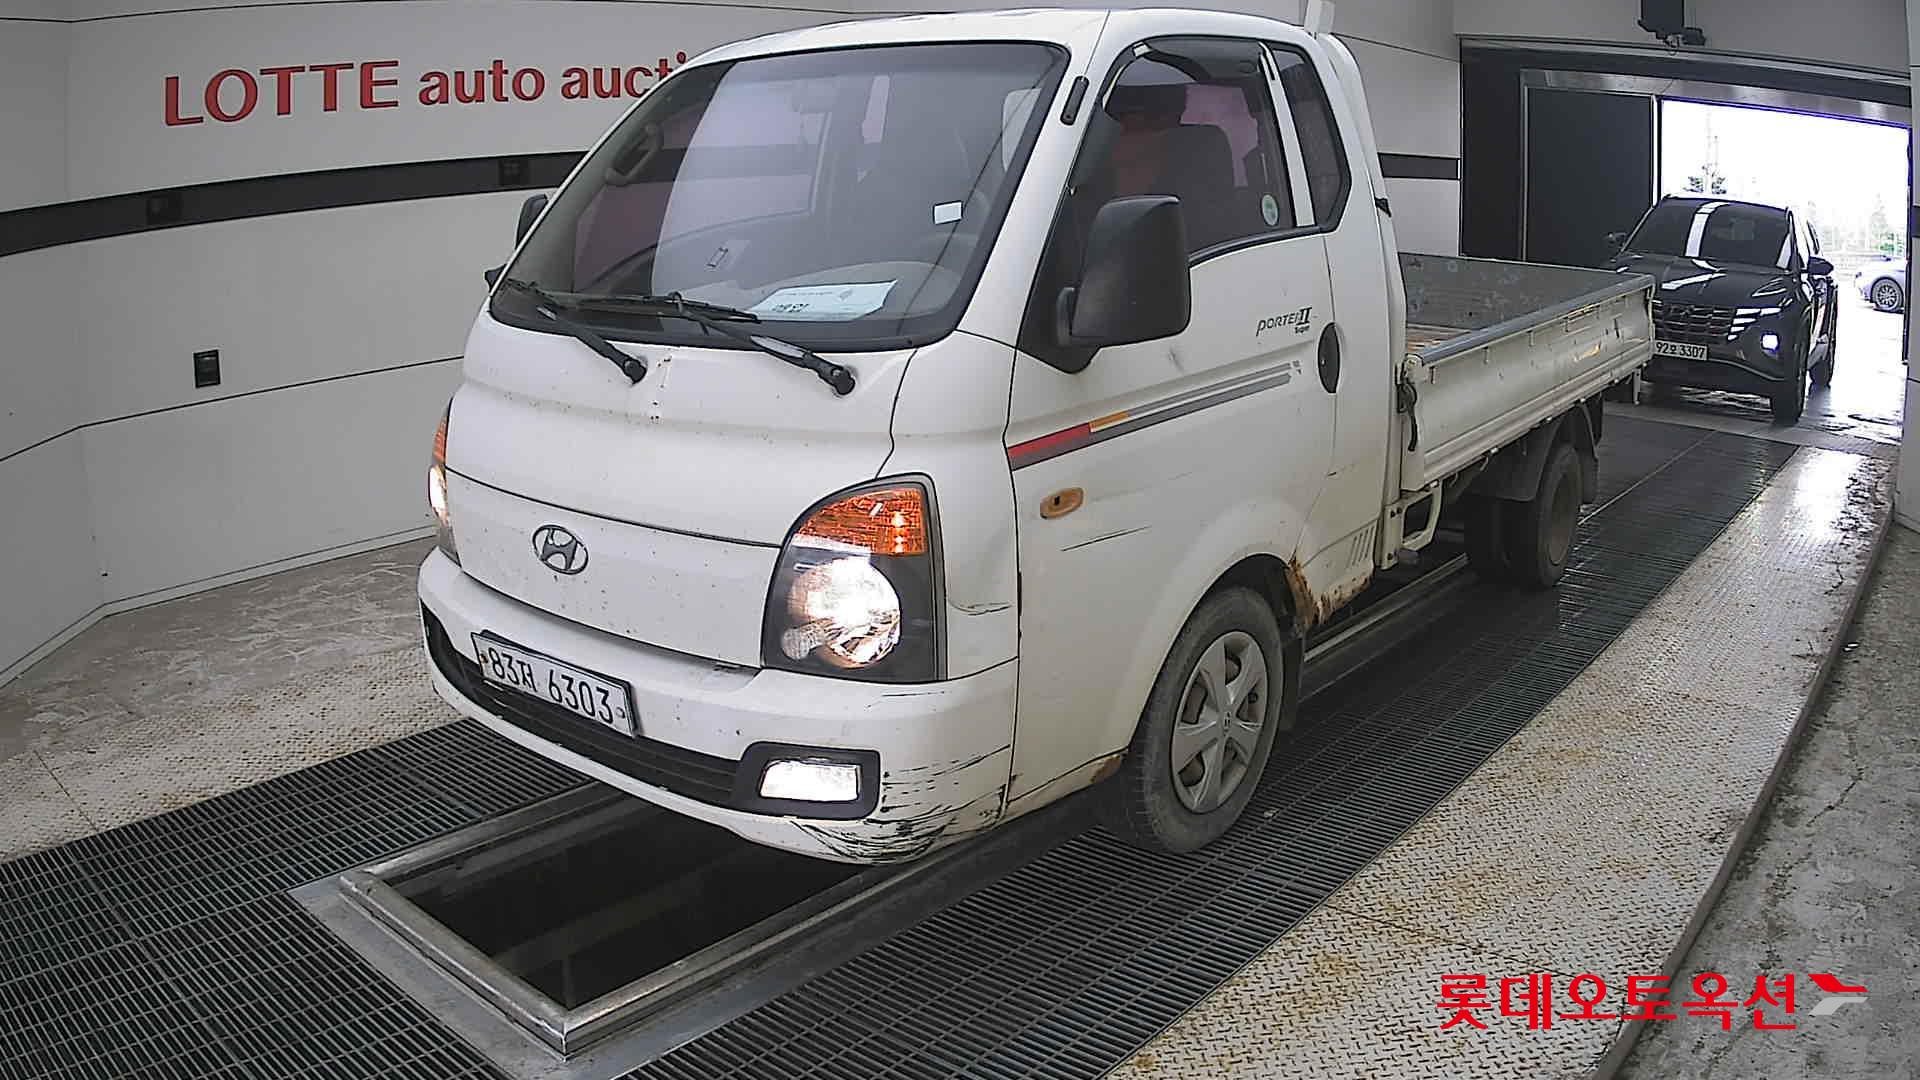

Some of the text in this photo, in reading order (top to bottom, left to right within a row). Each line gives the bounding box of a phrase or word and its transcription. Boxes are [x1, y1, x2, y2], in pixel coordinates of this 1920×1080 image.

[164, 51, 687, 126] LOTTE auto auct
[548, 669, 613, 724] 6303
